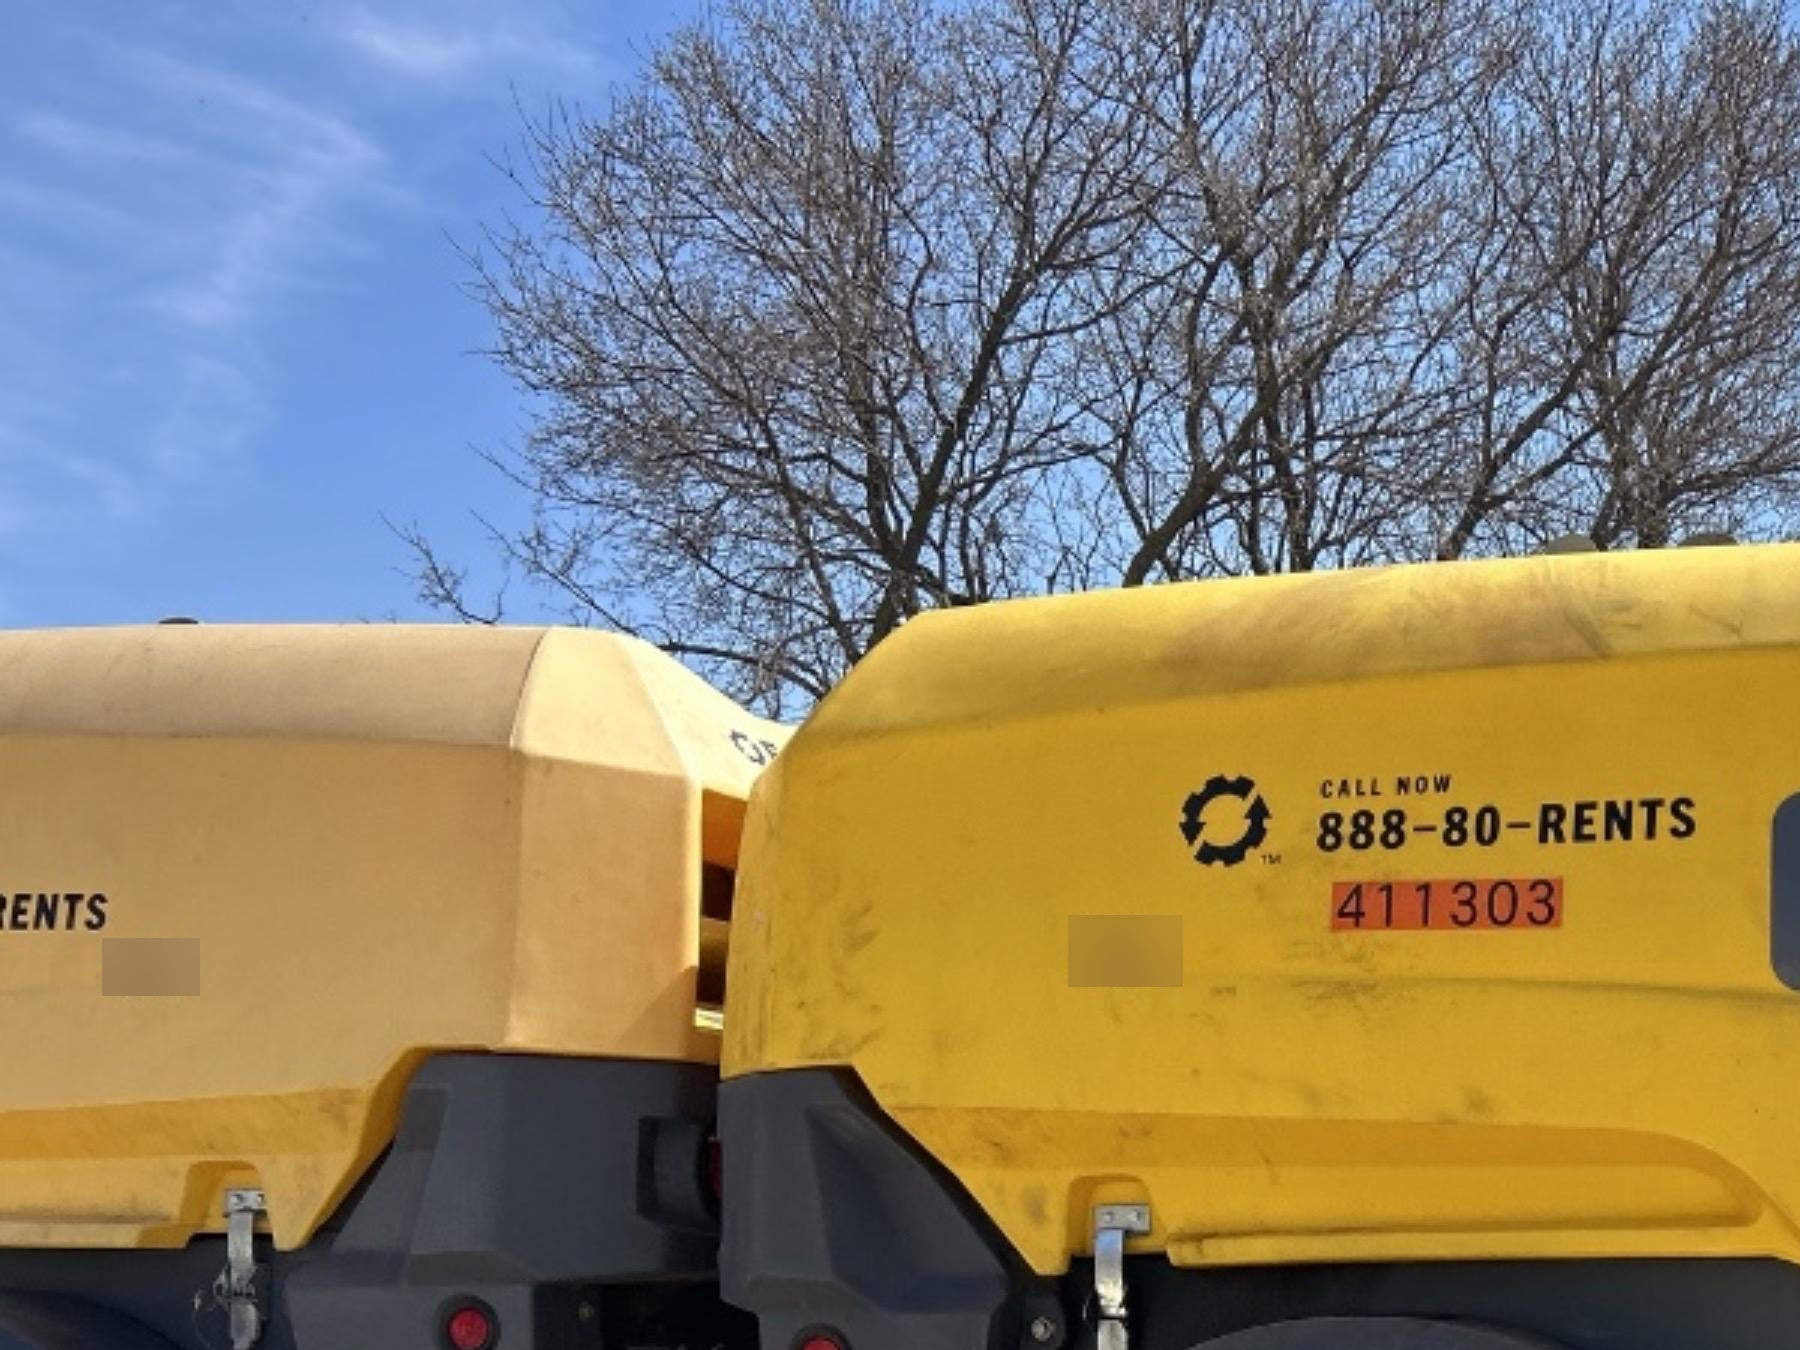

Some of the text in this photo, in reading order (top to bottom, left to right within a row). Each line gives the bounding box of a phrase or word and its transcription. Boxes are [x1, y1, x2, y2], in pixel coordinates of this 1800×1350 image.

[1320, 774, 1452, 798] CALL NOW
[1316, 798, 1696, 852] 888-80-RENTS
[1337, 879, 1556, 928] 411303
